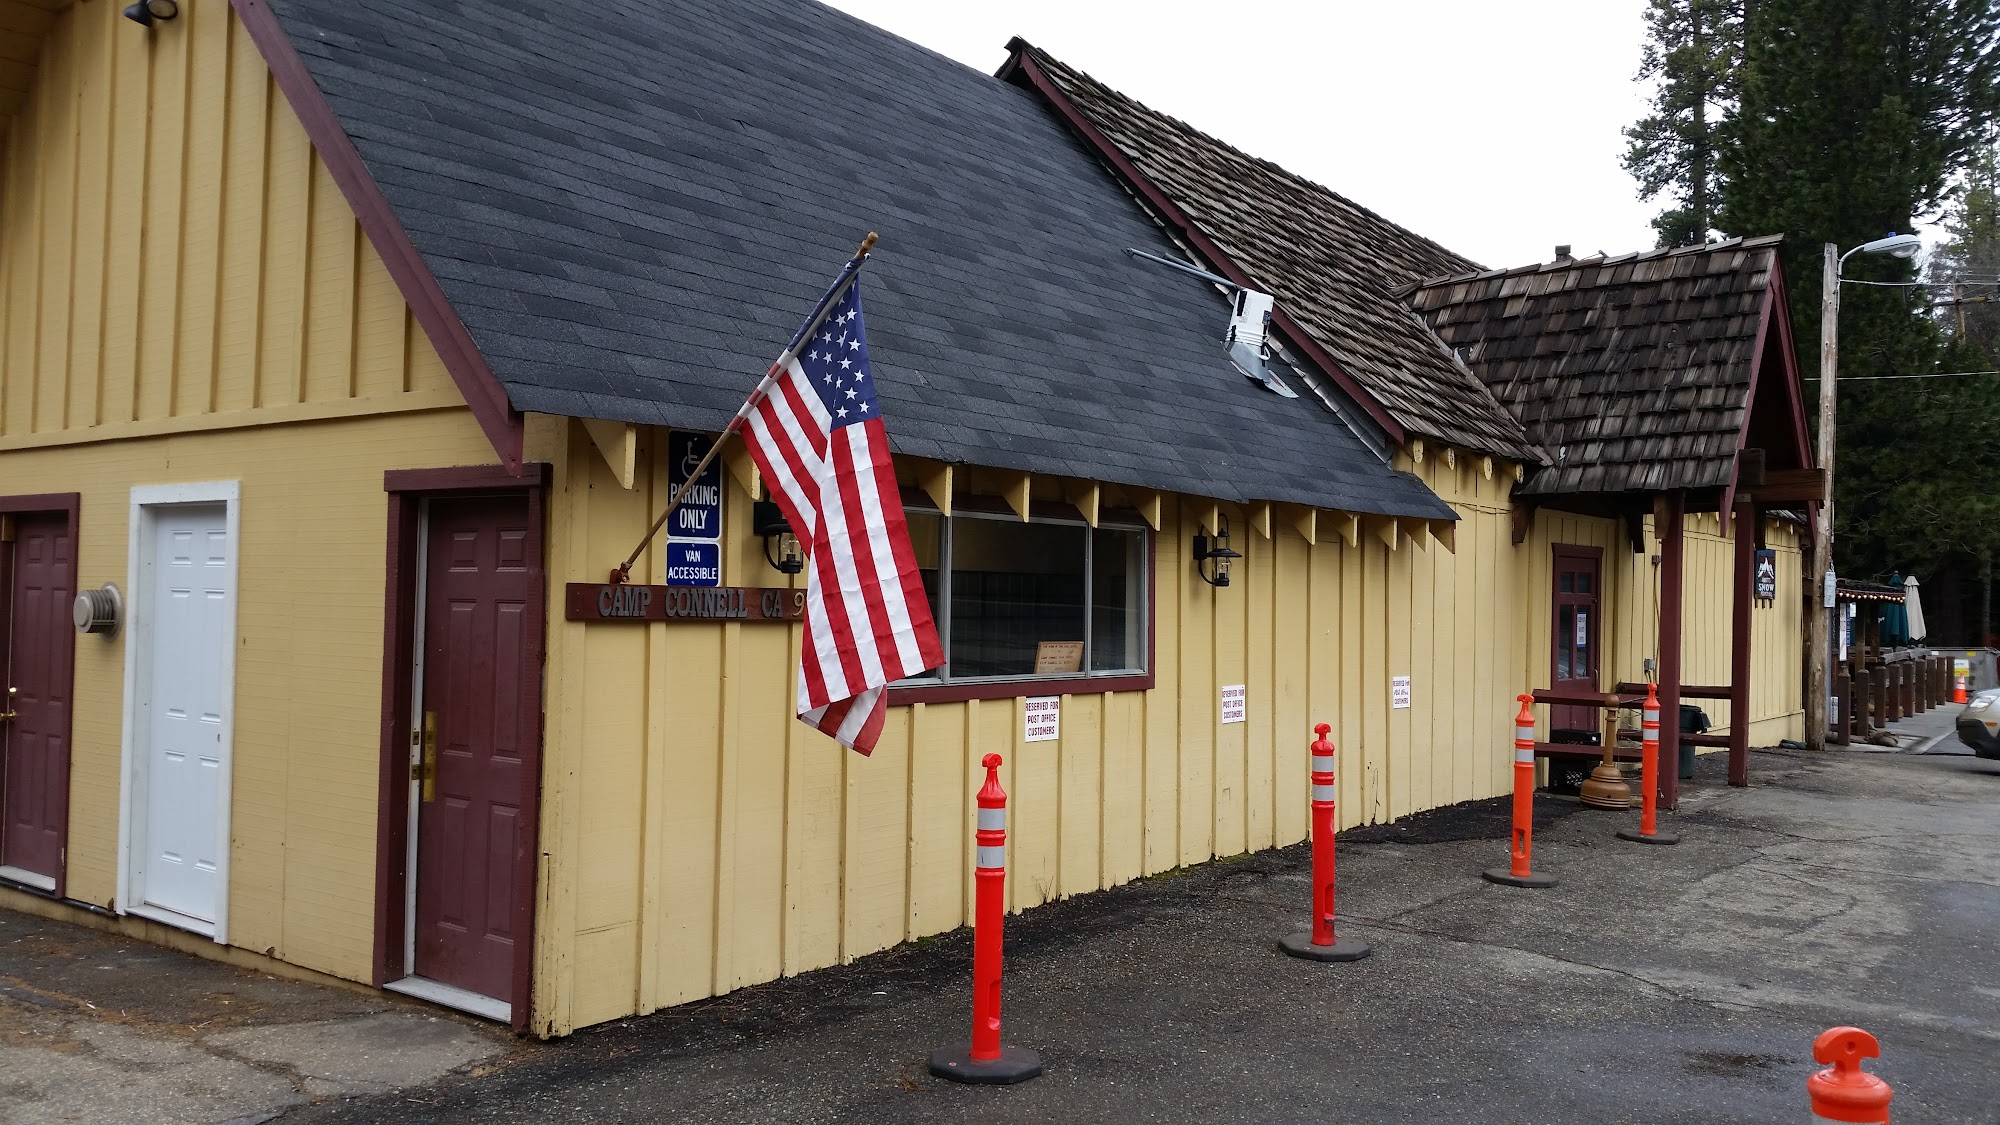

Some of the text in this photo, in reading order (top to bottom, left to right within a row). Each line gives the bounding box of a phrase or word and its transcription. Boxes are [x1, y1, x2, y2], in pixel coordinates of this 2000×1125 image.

[680, 508, 708, 529] ONLY
[685, 550, 701, 562] VAN
[668, 567, 717, 580] ACCESSIBLE
[1758, 583, 1774, 592] SNOW
[599, 587, 651, 618] CAMP
[665, 588, 748, 618] CONNELL
[761, 591, 783, 618] CA
[1025, 700, 1058, 712] RESERVED FOR
[1223, 699, 1243, 708] POST OFFICE
[1027, 713, 1056, 724] POST OFFICE
[1223, 710, 1243, 719] CUSTOMERS
[1027, 725, 1055, 737] CUSTOMERS
